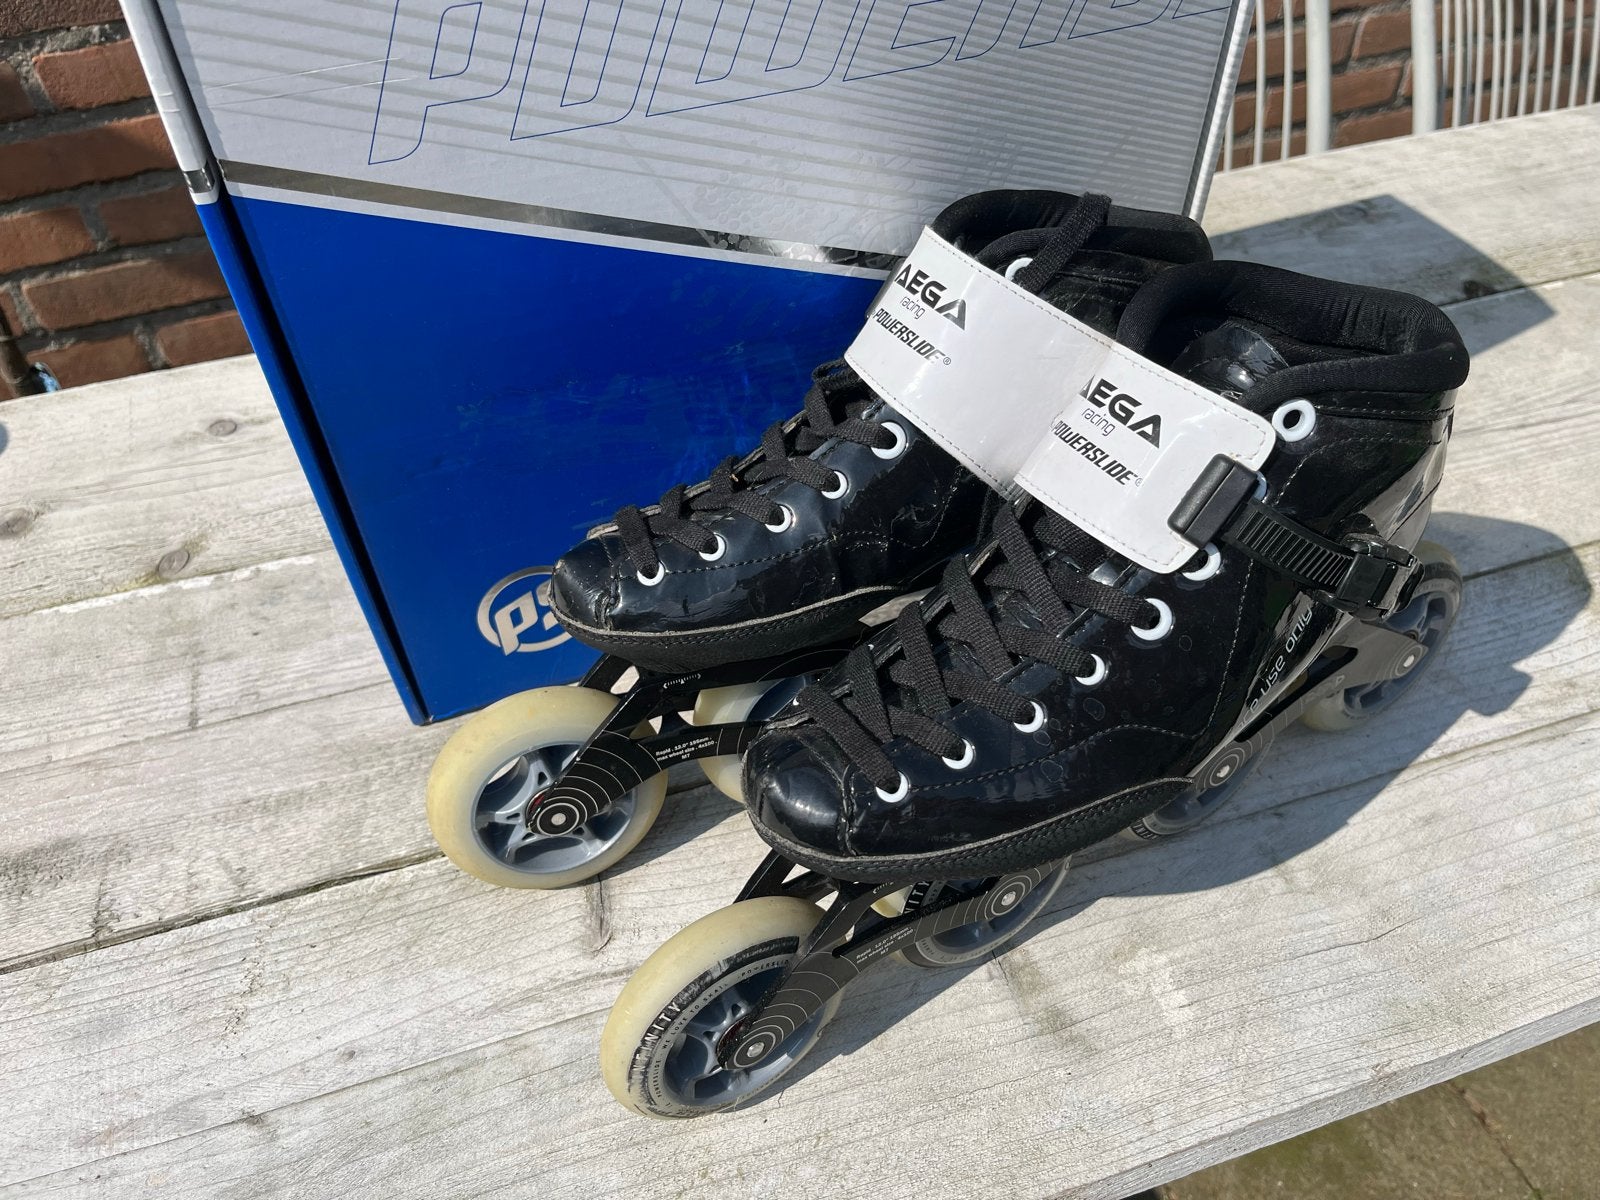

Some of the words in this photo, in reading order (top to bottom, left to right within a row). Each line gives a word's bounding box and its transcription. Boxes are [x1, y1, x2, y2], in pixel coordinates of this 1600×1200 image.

[900, 296, 926, 320] racing
[1081, 407, 1117, 437] racing
[1260, 655, 1286, 695] use
[1285, 605, 1313, 653] only
[669, 750, 684, 758] wheel
[671, 1017, 687, 1035] LOVE
[690, 1004, 700, 1013] TO
